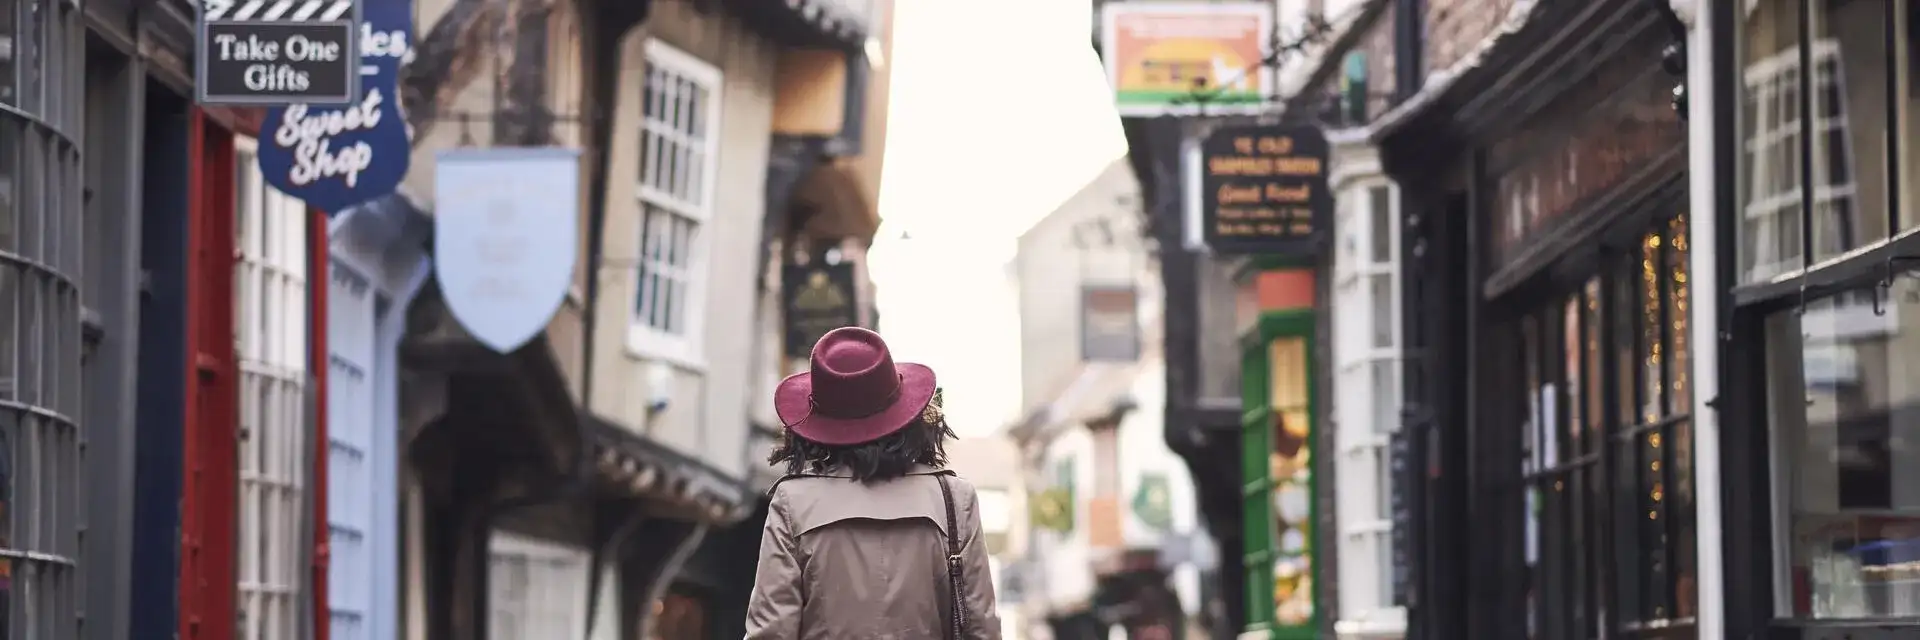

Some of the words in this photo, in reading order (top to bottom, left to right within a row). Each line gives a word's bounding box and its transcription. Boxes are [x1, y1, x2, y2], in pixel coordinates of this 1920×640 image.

[214, 34, 280, 61] Take
[285, 35, 339, 61] One
[244, 64, 309, 91] Gifts
[275, 87, 383, 147] Sweet
[289, 138, 372, 188] Shop
